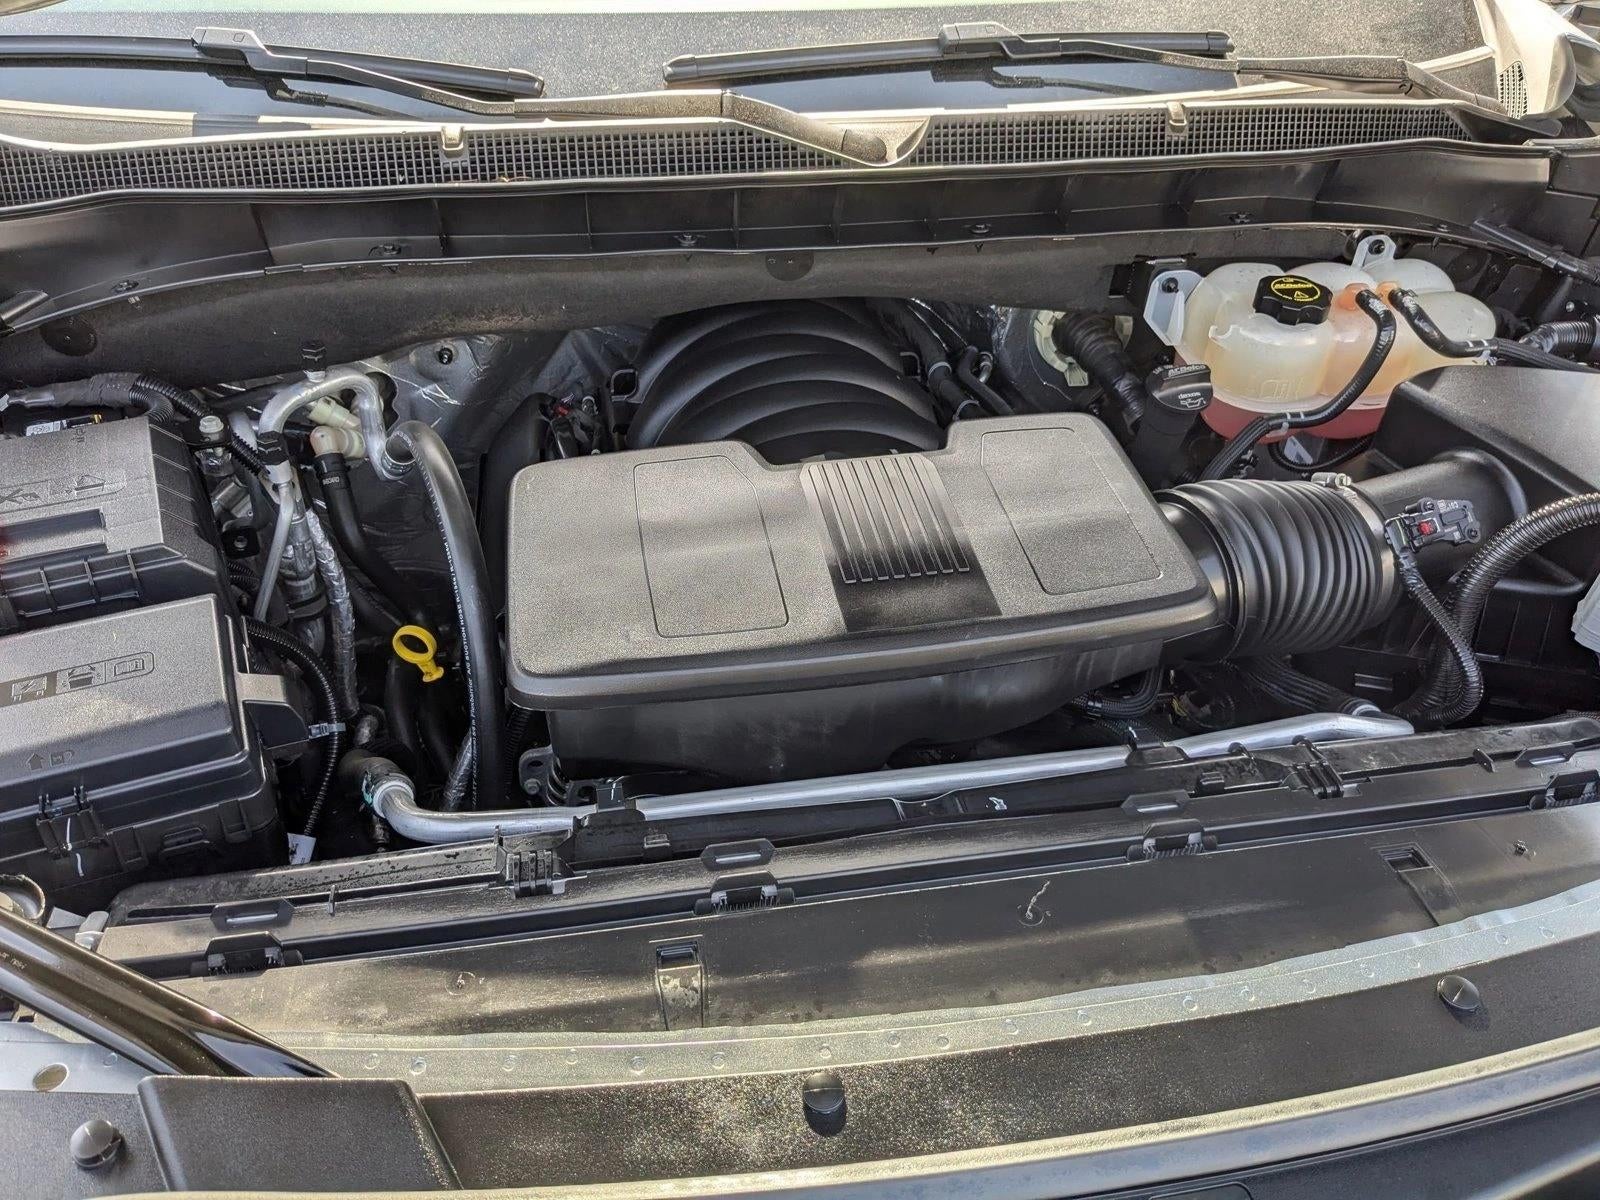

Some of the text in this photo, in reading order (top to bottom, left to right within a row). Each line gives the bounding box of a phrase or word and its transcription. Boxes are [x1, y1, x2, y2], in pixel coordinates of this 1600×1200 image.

[1168, 365, 1206, 377] ACDelco
[1178, 391, 1201, 399] dexos
[457, 603, 465, 626] HOSE
[462, 627, 470, 661] SUCTION
